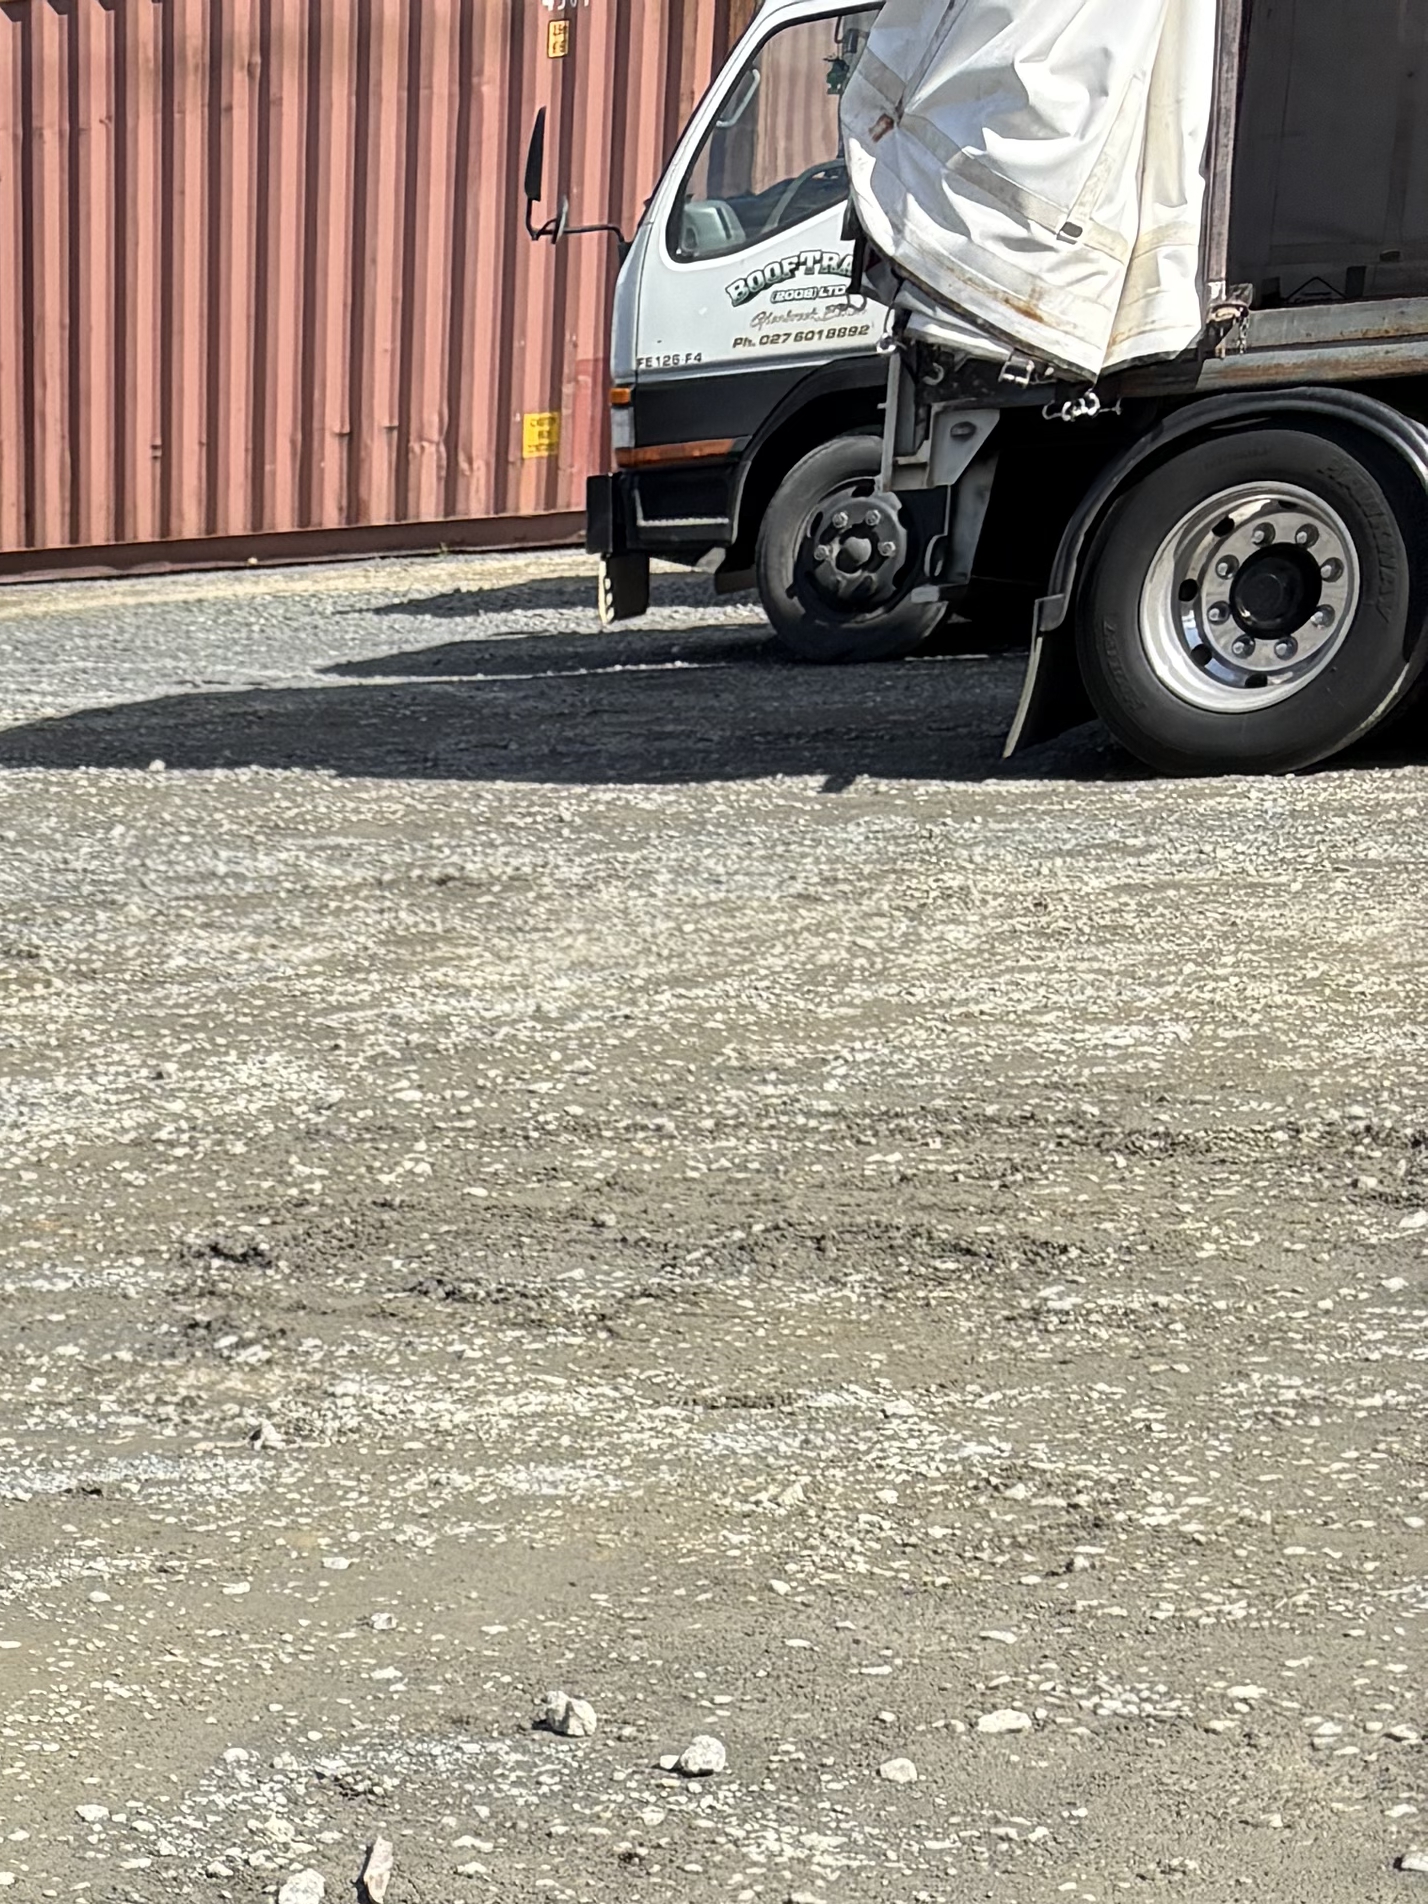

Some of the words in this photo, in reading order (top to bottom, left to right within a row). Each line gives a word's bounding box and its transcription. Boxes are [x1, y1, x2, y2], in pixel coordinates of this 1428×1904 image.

[725, 250, 854, 307] BOOFTRA
[818, 284, 846, 299] LTD
[758, 333, 792, 345] 027
[794, 324, 871, 343] 6018892
